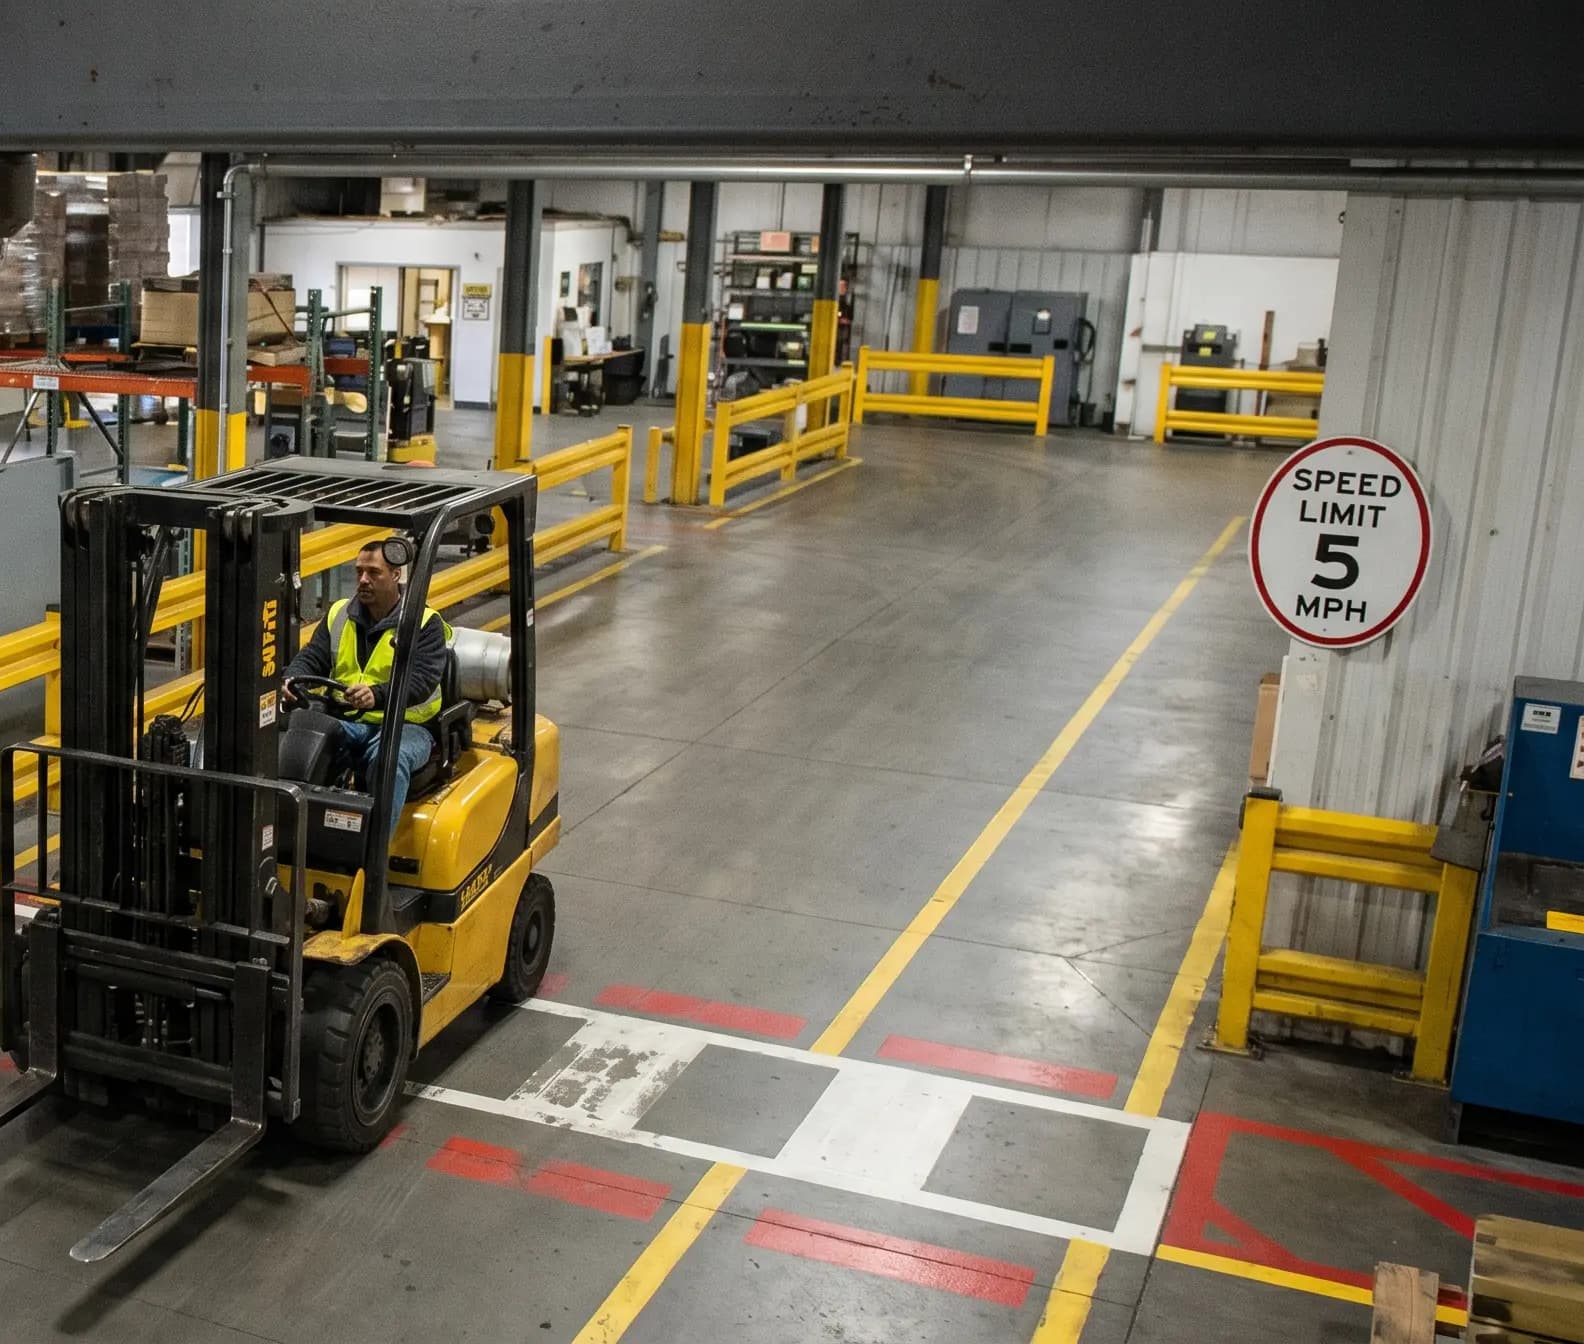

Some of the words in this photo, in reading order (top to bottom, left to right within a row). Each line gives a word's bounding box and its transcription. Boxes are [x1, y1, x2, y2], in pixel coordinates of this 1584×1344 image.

[1292, 468, 1401, 497] SPEED
[1299, 500, 1386, 528] LIMIT
[1311, 533, 1360, 590] 5
[1295, 595, 1367, 623] MPH
